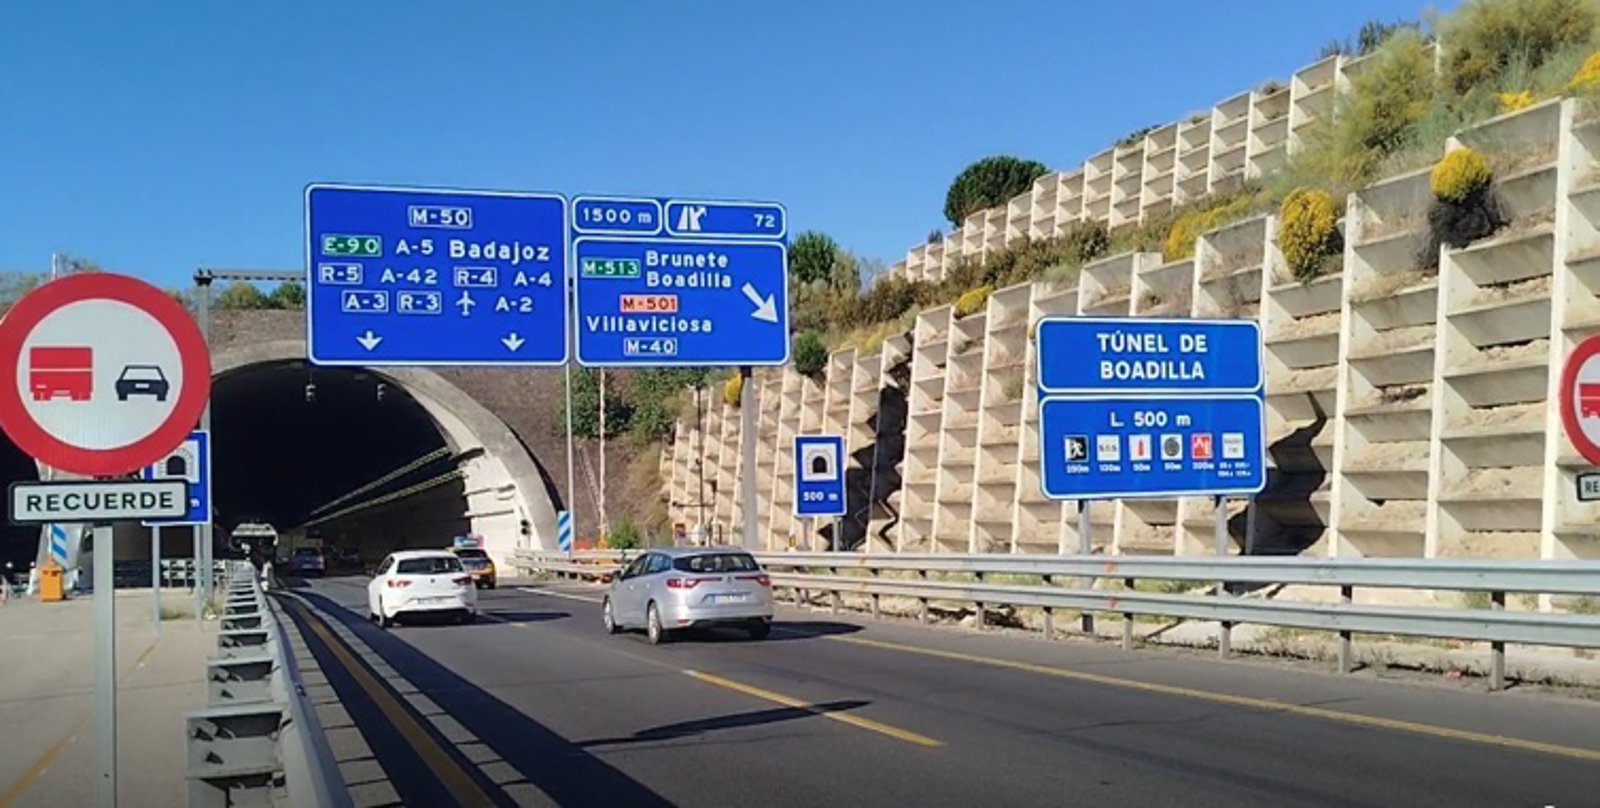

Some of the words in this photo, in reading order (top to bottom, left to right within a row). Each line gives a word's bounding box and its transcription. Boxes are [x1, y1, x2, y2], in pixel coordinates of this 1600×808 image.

[412, 208, 469, 226] M-50
[583, 207, 631, 224] 1500
[638, 211, 652, 224] m
[753, 214, 776, 228] 72
[323, 236, 379, 254] E-90
[395, 239, 434, 255] A-5
[449, 239, 550, 265] Badajoz
[583, 260, 638, 275] M-513
[645, 250, 729, 268] Brunete
[321, 266, 360, 283] R-5
[381, 268, 438, 285] A-42
[456, 269, 494, 285] R-4
[513, 271, 552, 287] A-4
[646, 271, 732, 288] Boadilla
[345, 293, 385, 309] A-3
[400, 294, 439, 311] R-3
[495, 296, 533, 313] A-2
[623, 297, 676, 310] M-501
[586, 315, 713, 333] Villaviciosa
[626, 339, 674, 353] M-40
[1096, 329, 1169, 353] TÚNEL
[1179, 334, 1208, 353] DE
[1100, 360, 1206, 380] BOADILLA
[1133, 411, 1168, 427] 500
[1176, 414, 1191, 427] m
[26, 491, 174, 512] RECUERDE
